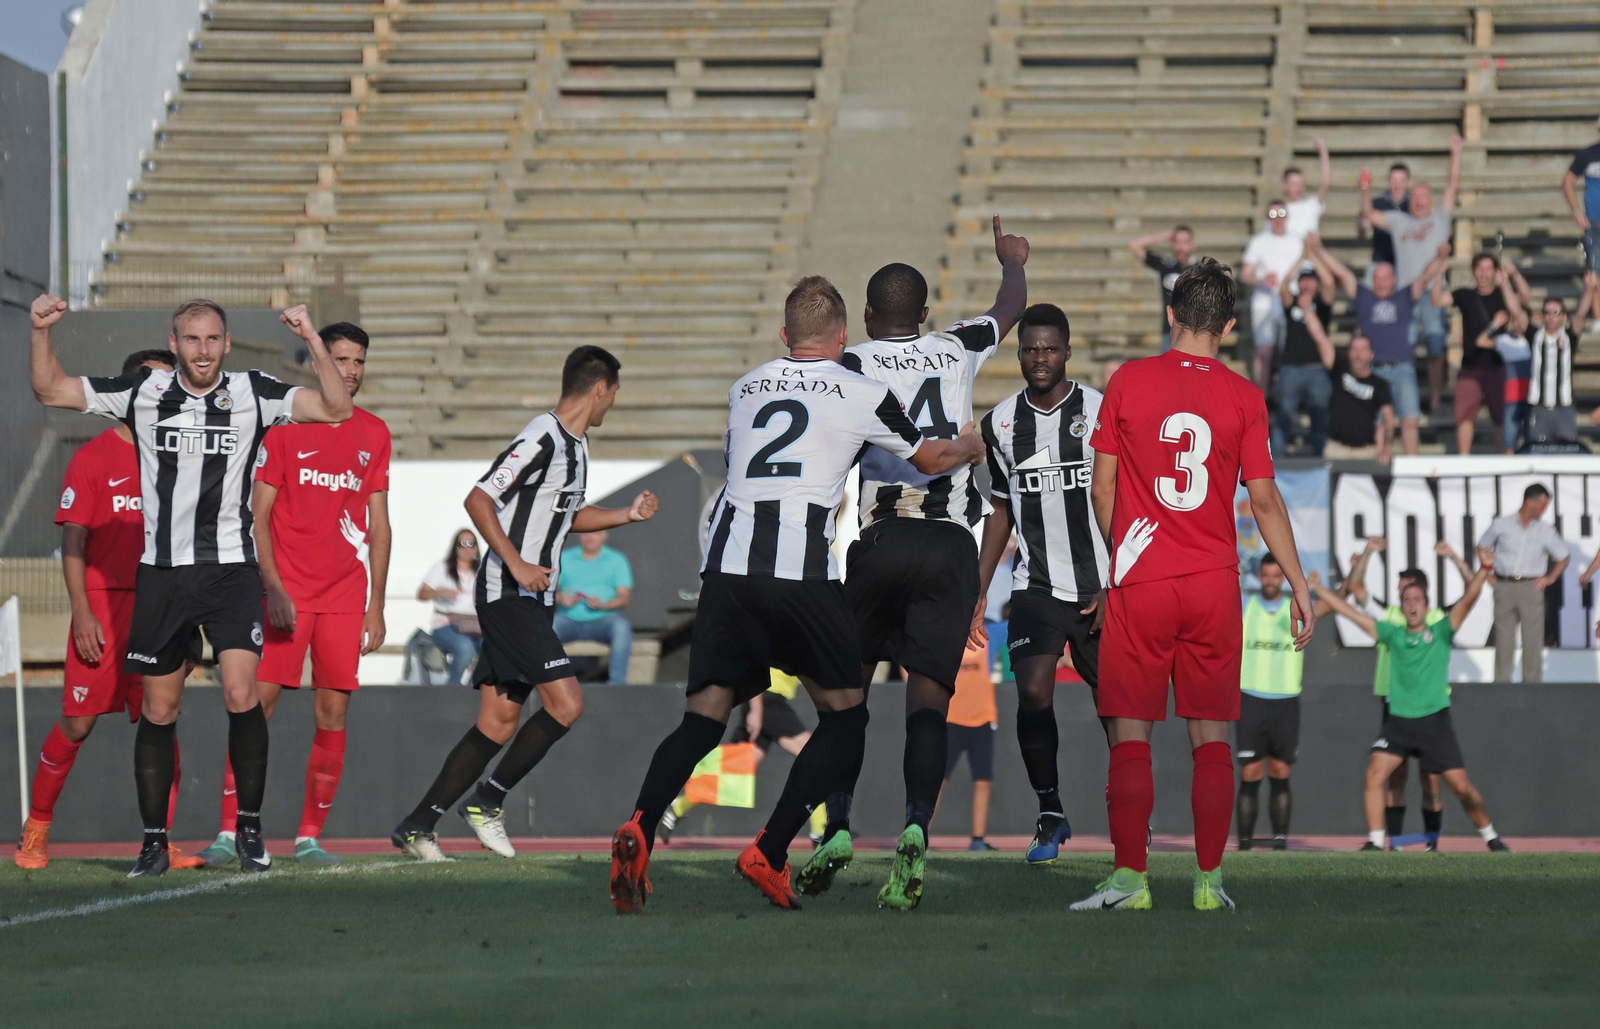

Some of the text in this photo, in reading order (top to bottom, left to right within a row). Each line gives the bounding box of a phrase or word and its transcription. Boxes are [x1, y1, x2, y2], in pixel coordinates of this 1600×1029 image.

[903, 344, 925, 355] LA
[782, 367, 806, 379] LA
[740, 379, 846, 399] SERRANA
[907, 375, 959, 441] 4
[151, 429, 238, 455] LOTUS
[745, 398, 810, 479] 2
[1154, 412, 1212, 512] 3
[1015, 466, 1092, 493] LOTUS
[112, 494, 144, 514] Pla
[1246, 640, 1292, 652] LEGEA
[544, 657, 571, 670] LEGEA
